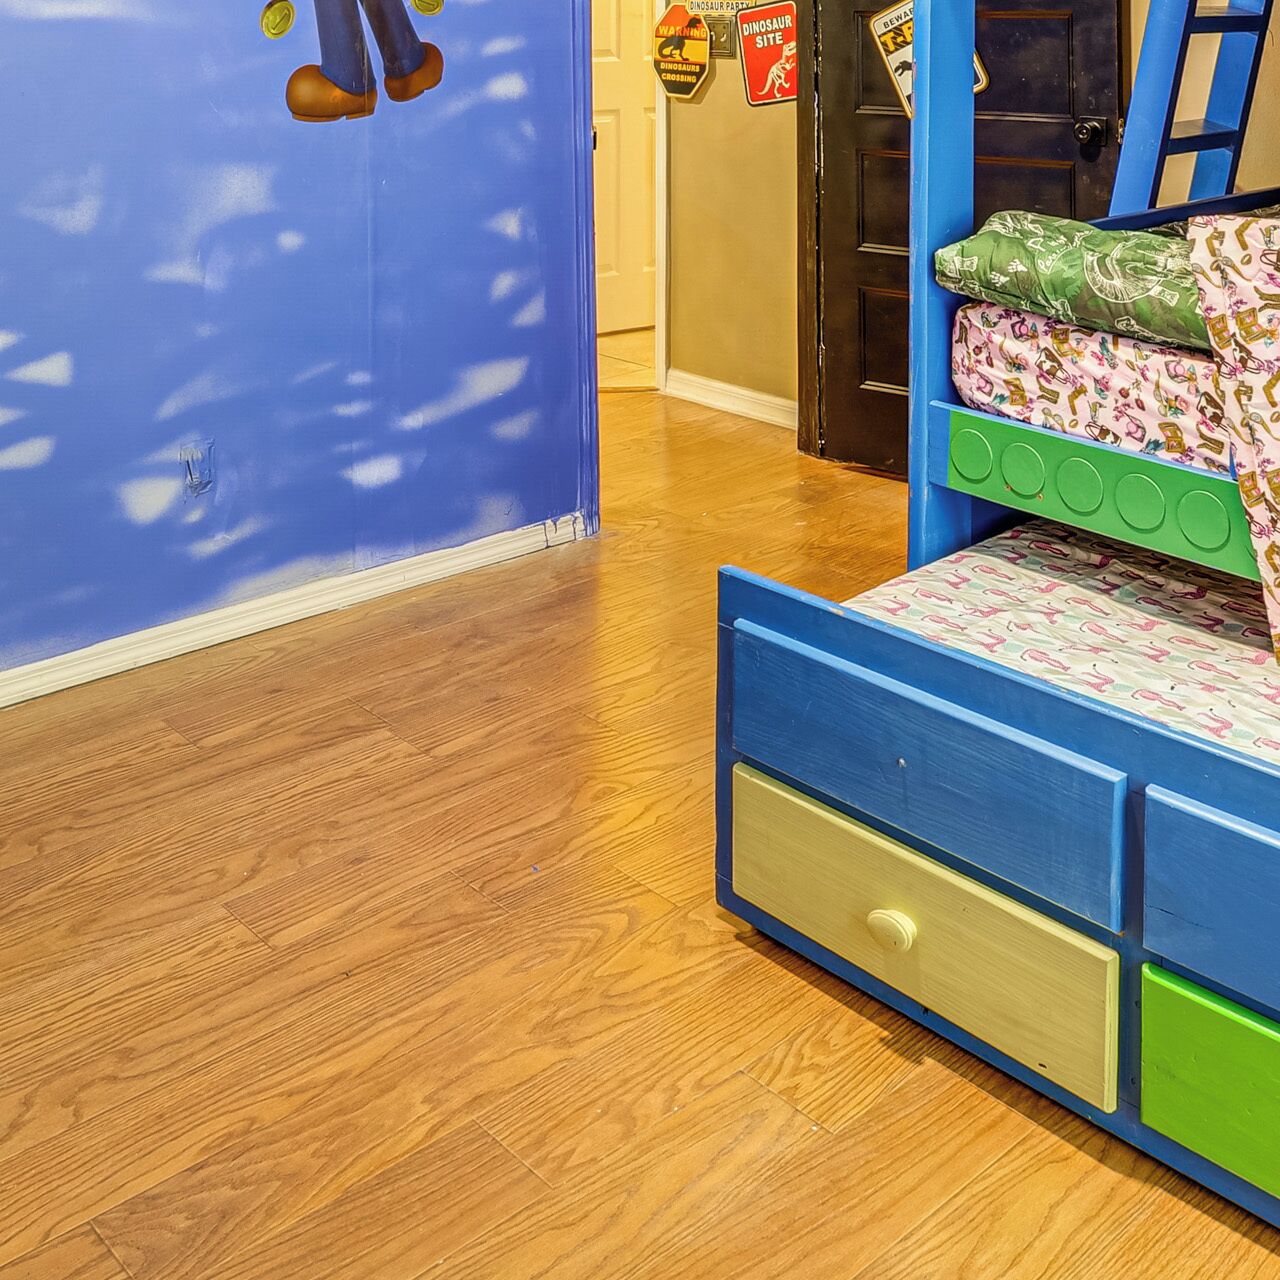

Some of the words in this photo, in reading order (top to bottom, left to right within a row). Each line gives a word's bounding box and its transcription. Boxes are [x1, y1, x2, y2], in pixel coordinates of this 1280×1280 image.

[690, 0, 725, 11] DINOSAUR
[726, 1, 750, 11] PARTY
[742, 15, 792, 36] DINOSAUR
[883, 7, 914, 30] BEWAR
[658, 25, 707, 38] WARNING
[880, 20, 914, 52] T-R
[755, 32, 784, 48] SITE
[660, 62, 700, 72] DINOSAURS
[661, 73, 697, 83] CROSSING
